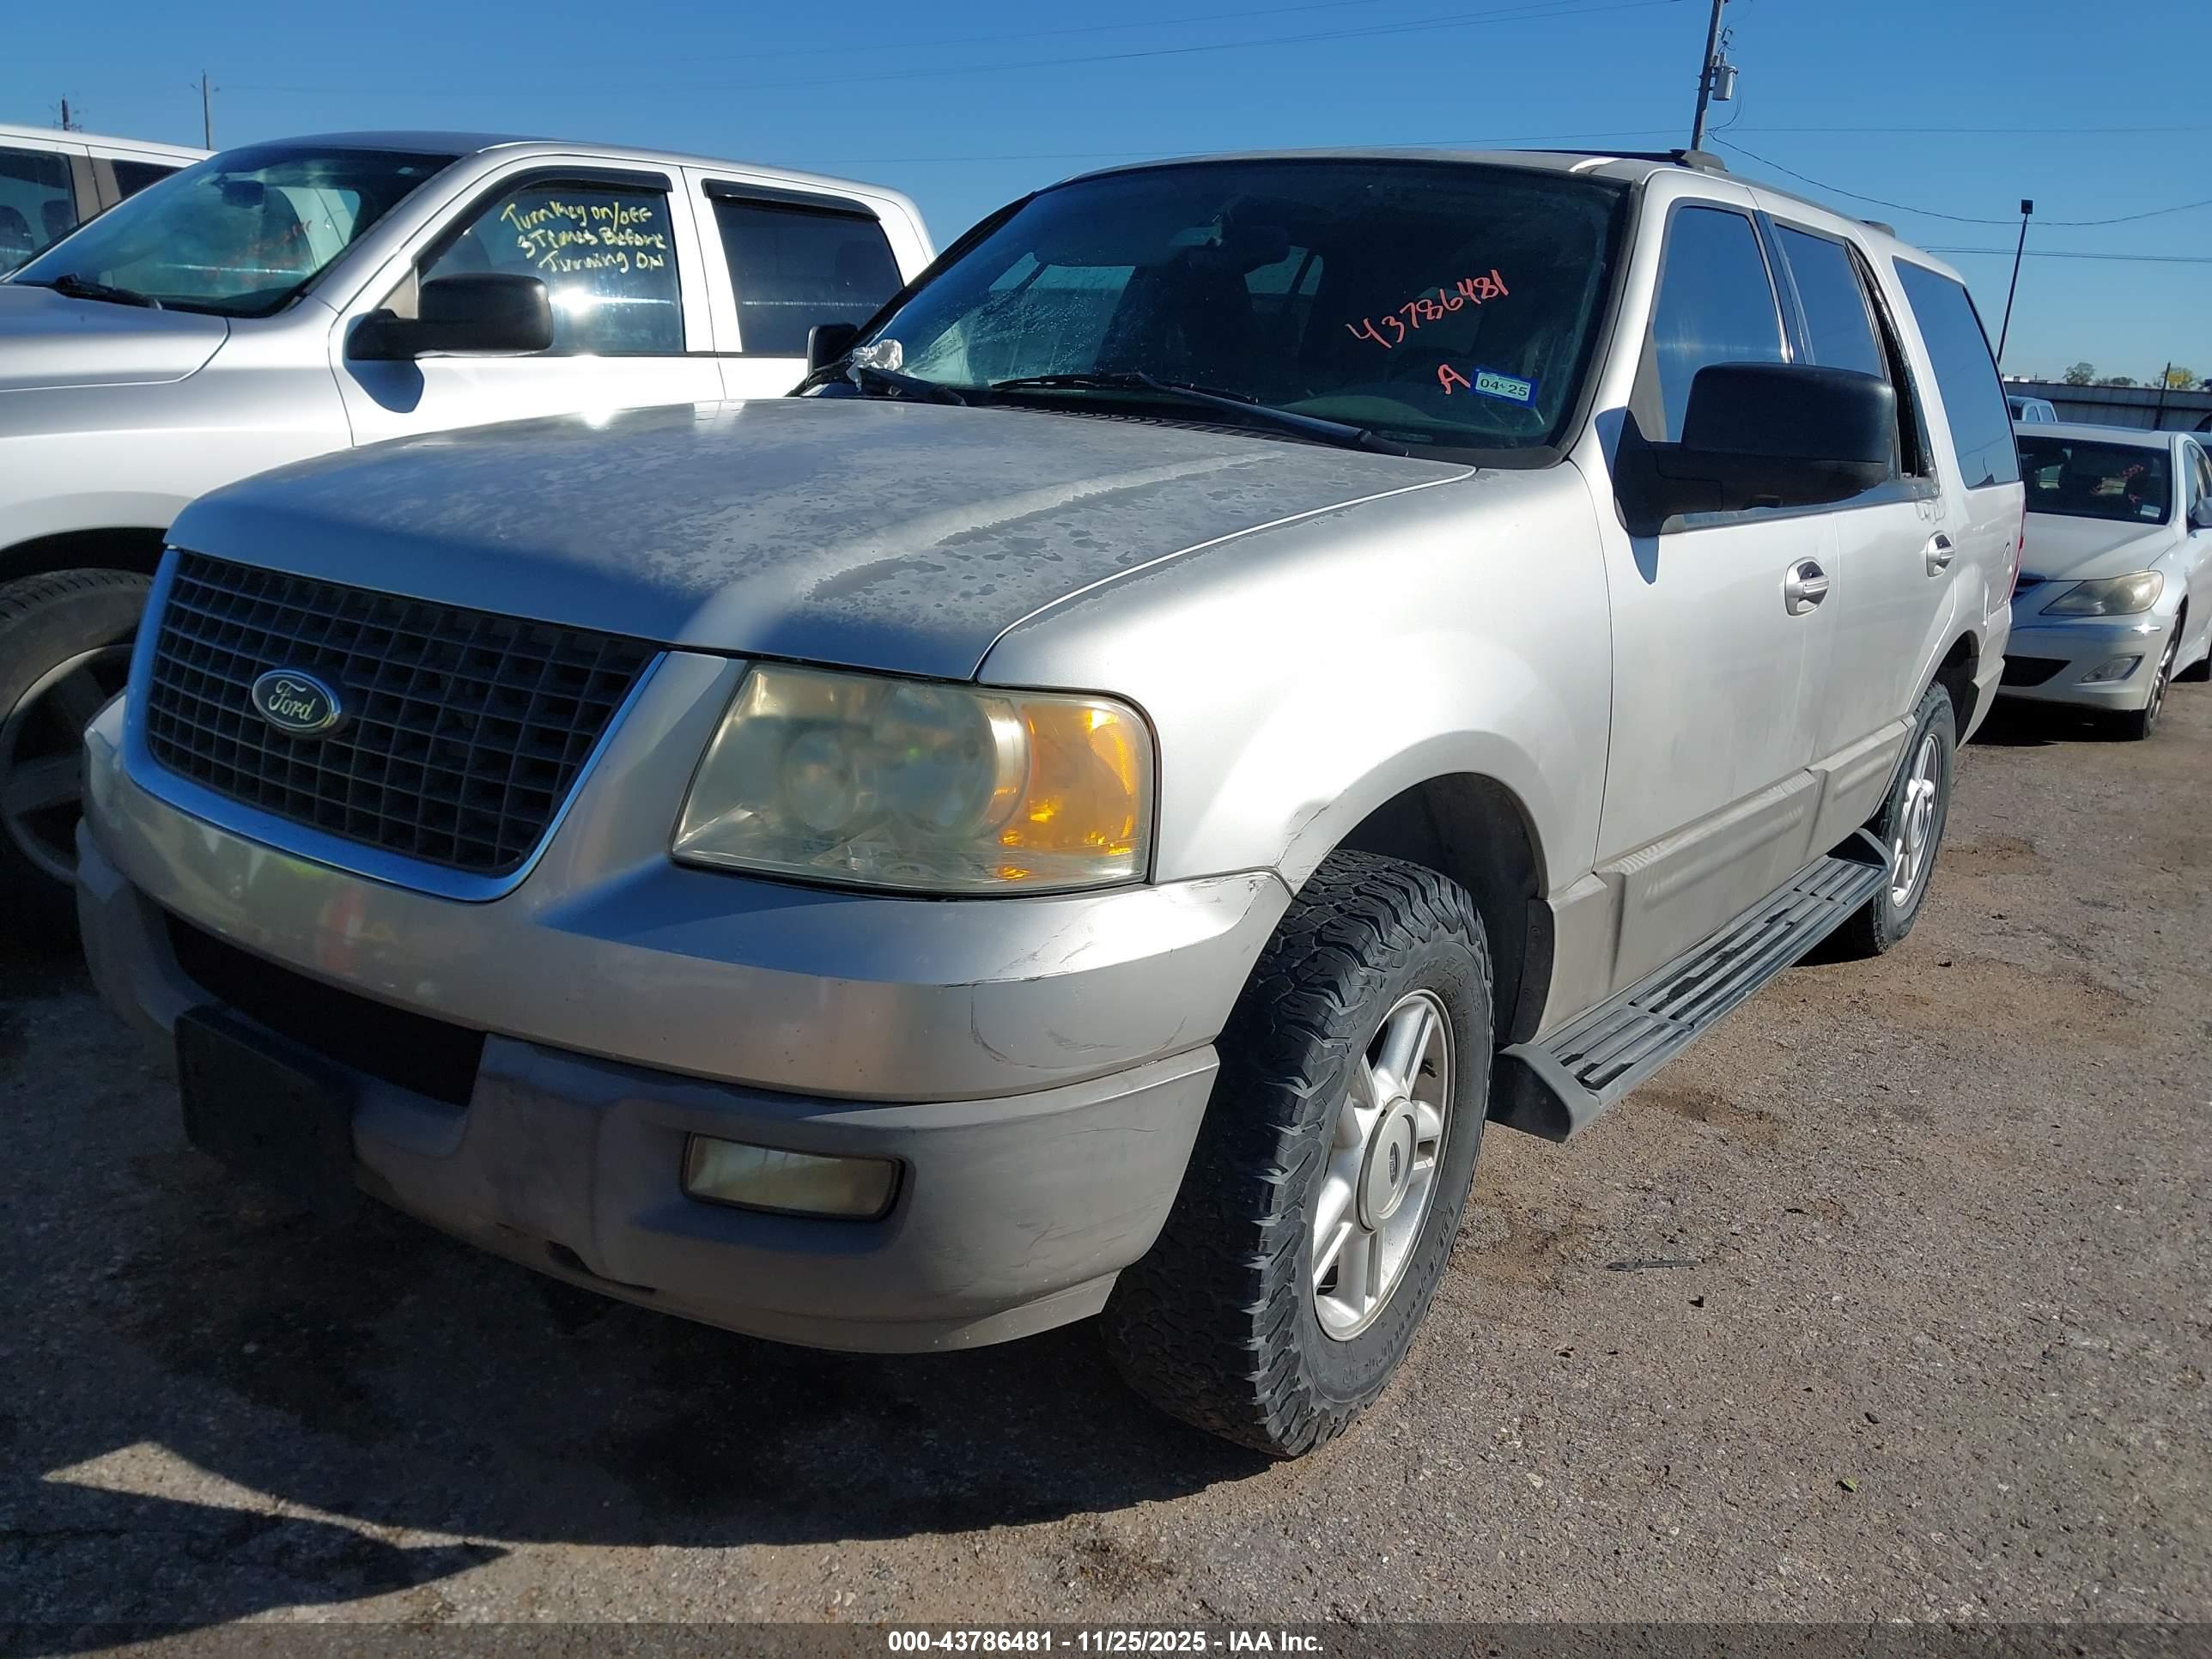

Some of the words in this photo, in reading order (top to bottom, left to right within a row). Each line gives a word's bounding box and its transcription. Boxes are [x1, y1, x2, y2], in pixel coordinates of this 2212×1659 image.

[516, 234, 537, 259] 3
[538, 250, 629, 274] Turning
[1345, 269, 1510, 349] 43786481
[1437, 363, 1471, 395] A
[267, 679, 317, 721] Ford
